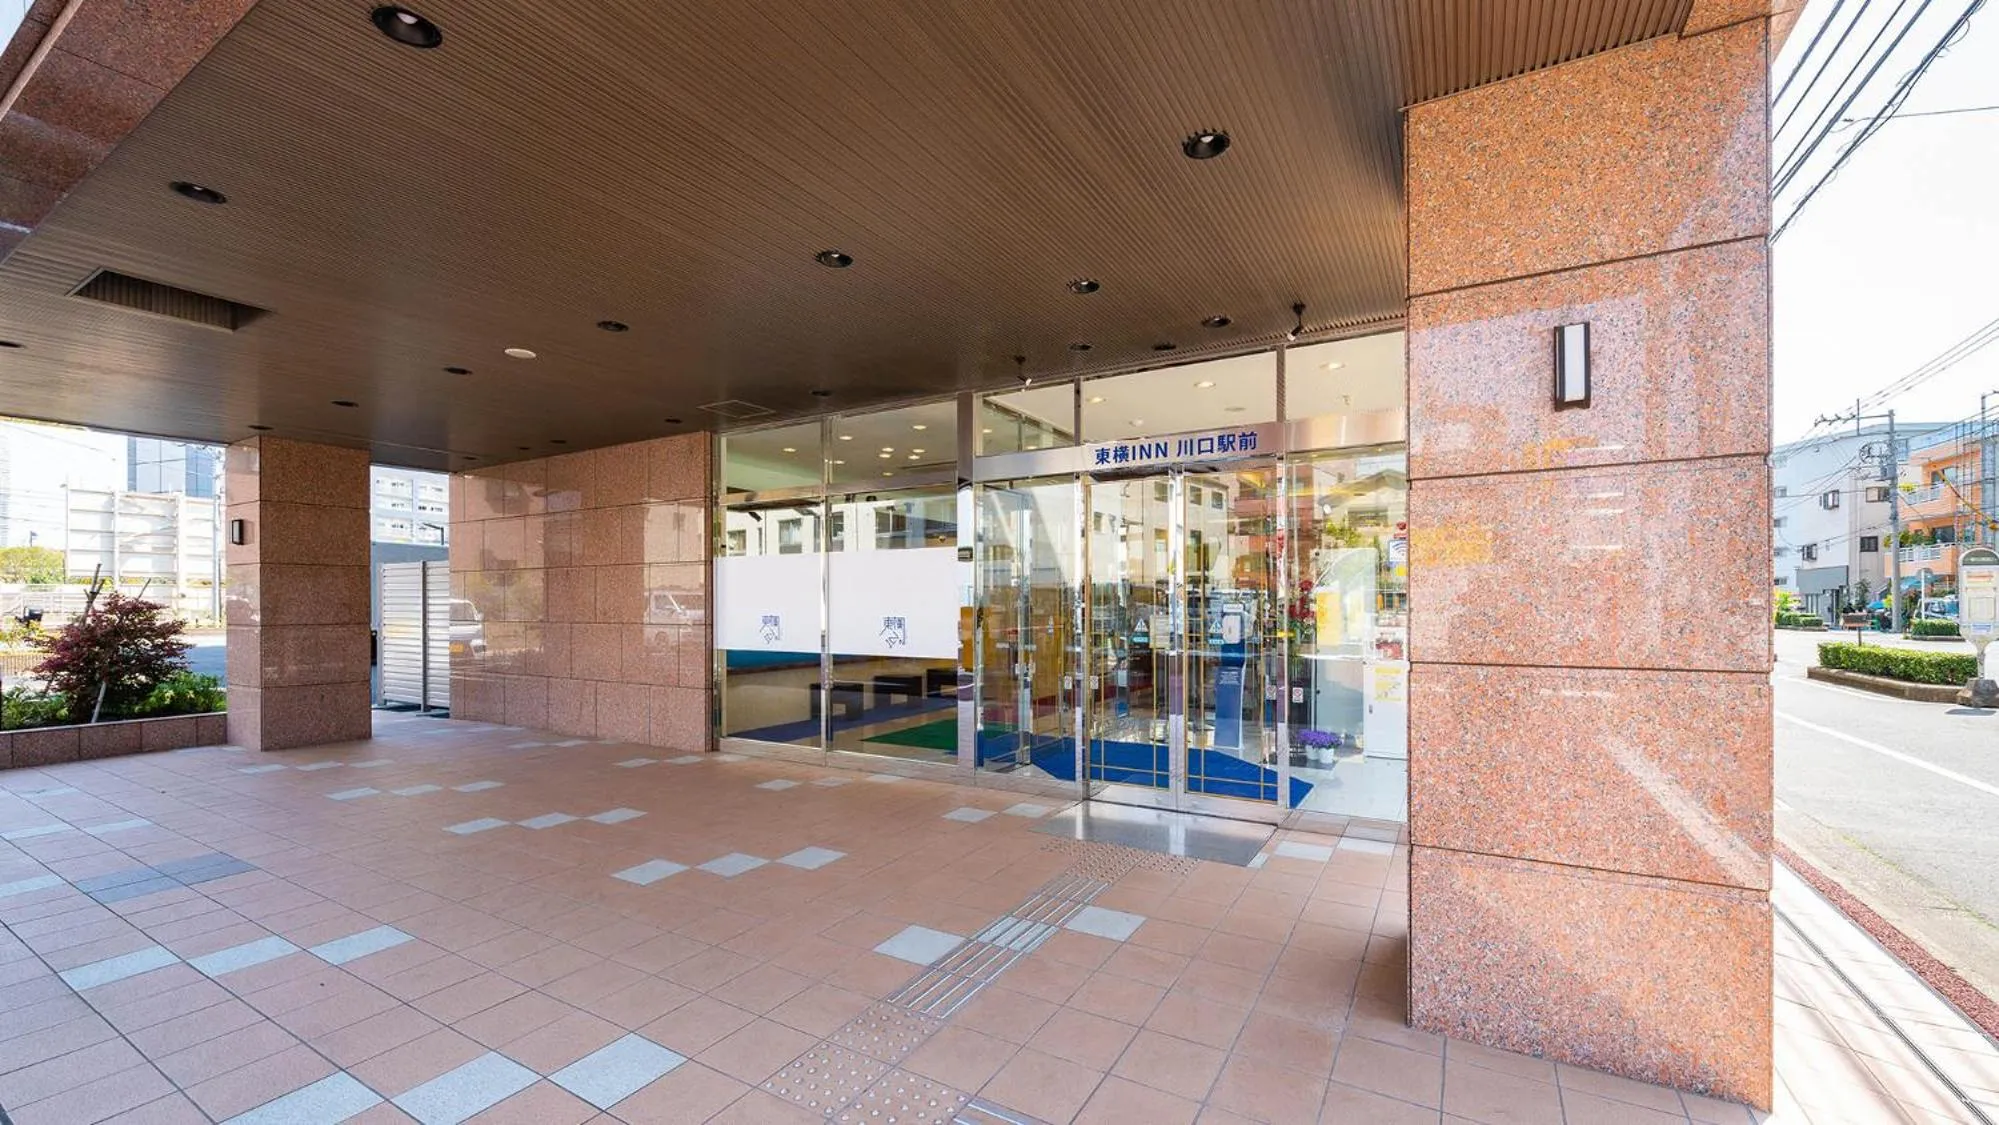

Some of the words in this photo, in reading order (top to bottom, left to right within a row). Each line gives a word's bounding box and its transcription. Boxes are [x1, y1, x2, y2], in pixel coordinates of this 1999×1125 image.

[1095, 441, 1168, 465] 東横INN
[1176, 431, 1258, 457] 川口駅前
